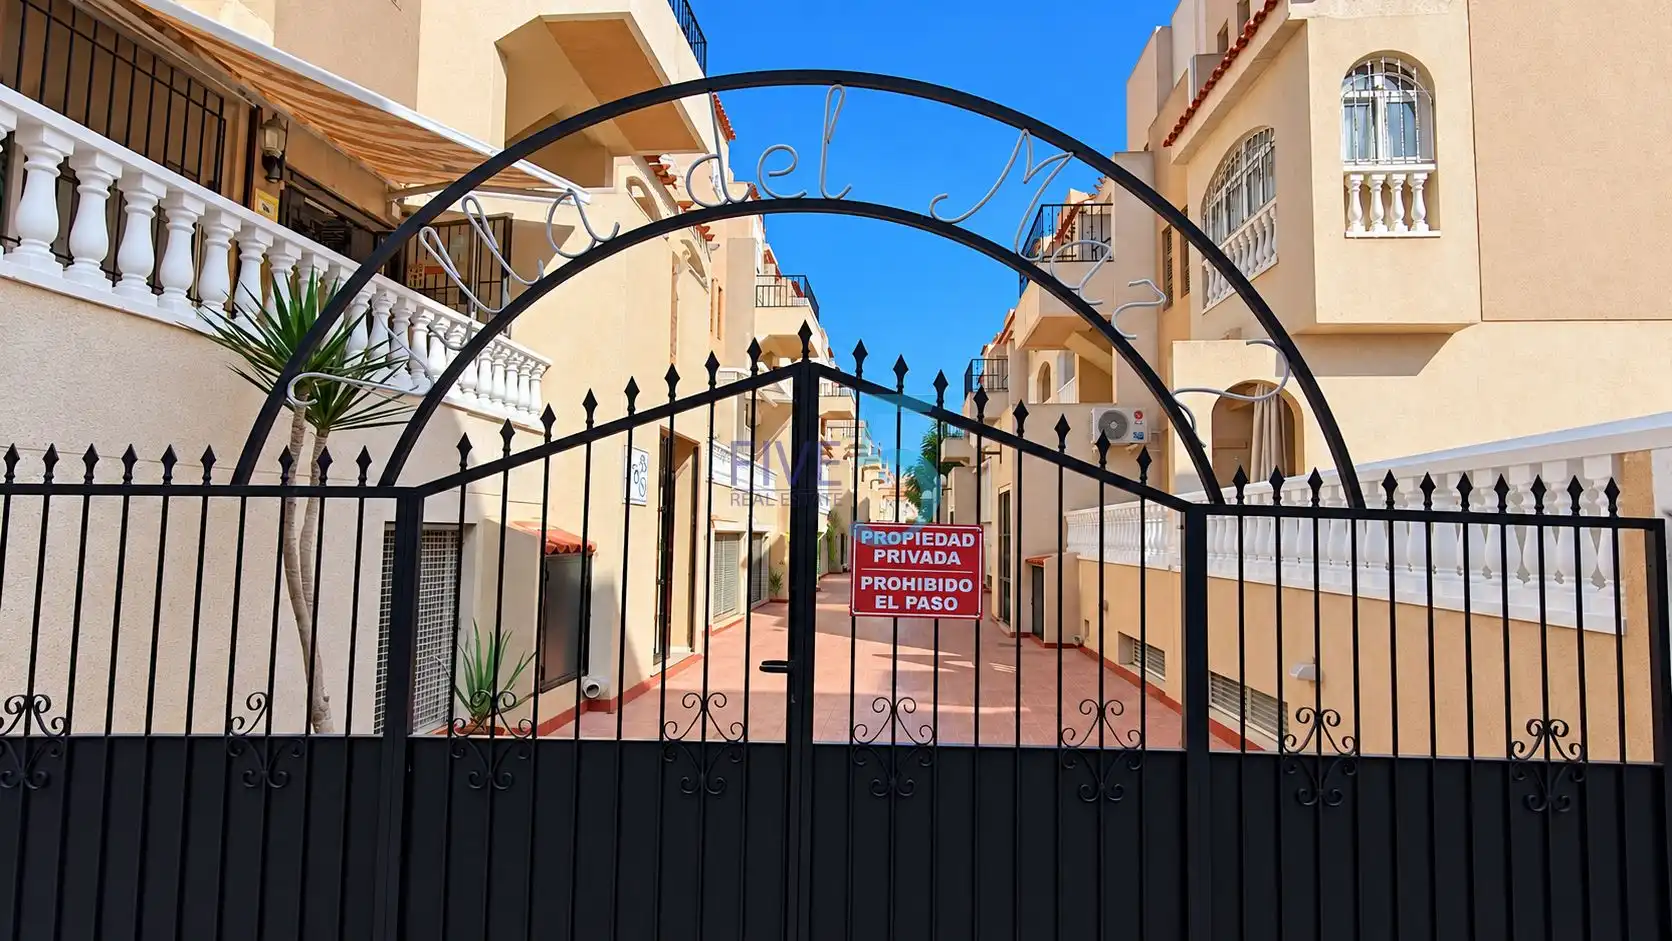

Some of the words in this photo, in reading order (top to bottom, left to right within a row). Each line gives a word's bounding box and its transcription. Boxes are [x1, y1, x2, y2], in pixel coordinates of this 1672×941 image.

[686, 84, 852, 207] del
[861, 531, 975, 547] PROPIEDAD
[873, 549, 961, 565] PRIVADA
[860, 576, 973, 593] PROHIBIDO
[875, 595, 899, 609] EL
[905, 596, 958, 611] PASO
